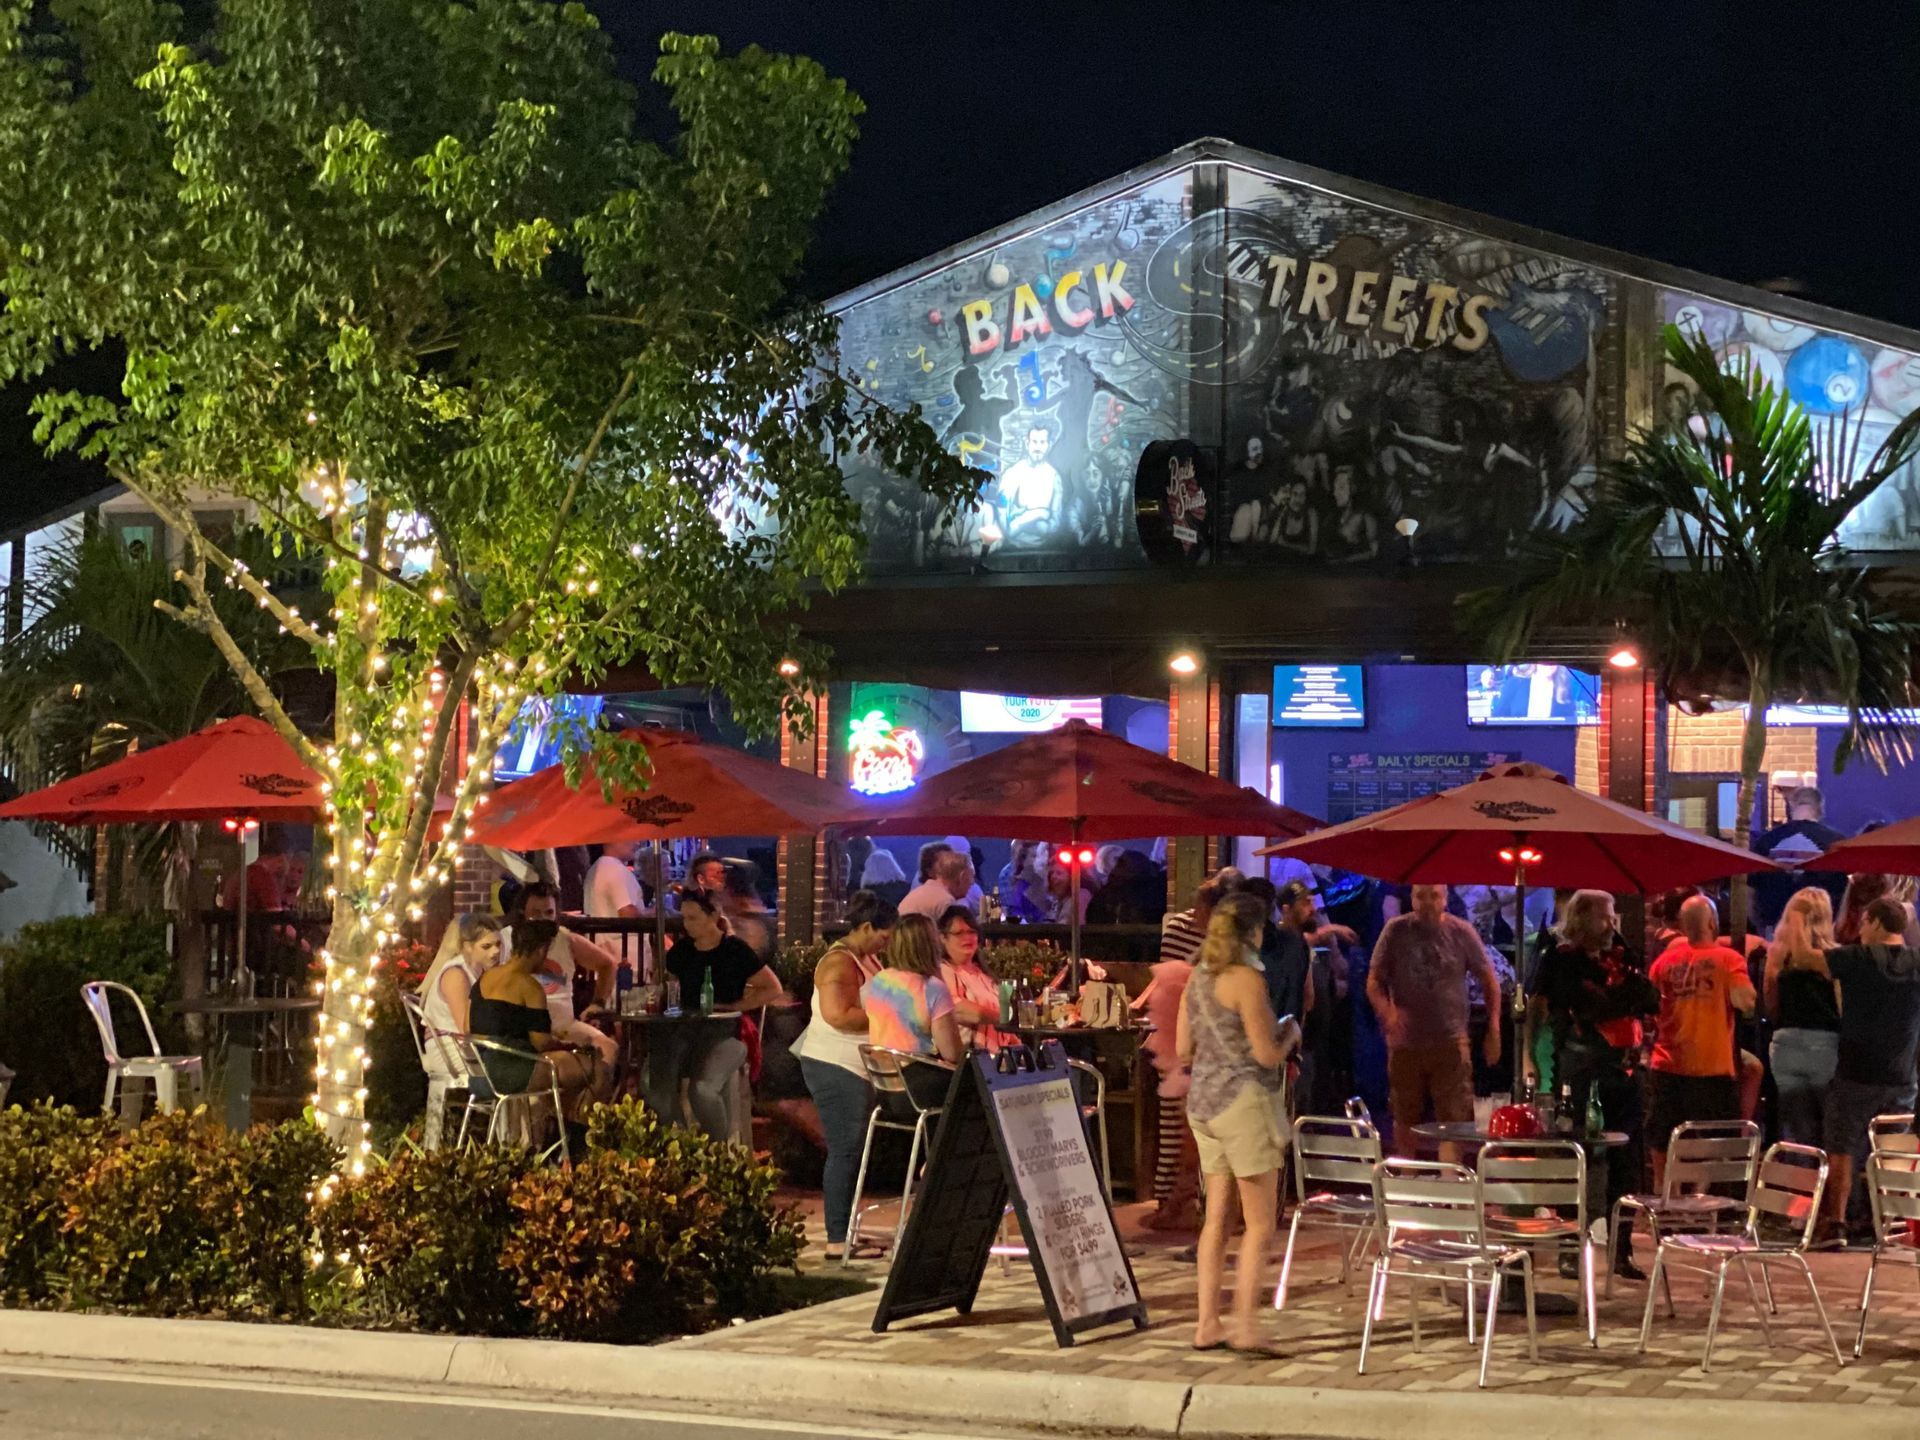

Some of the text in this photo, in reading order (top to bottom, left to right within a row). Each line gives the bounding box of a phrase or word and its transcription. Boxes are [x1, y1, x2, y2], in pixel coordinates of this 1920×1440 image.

[963, 259, 1136, 356] BACK
[1020, 708, 1041, 717] 2020
[1378, 755, 1411, 767] DAILY
[1413, 755, 1470, 767] SPECIALS
[1036, 1087, 1070, 1104] SPECIALS
[1051, 1138, 1079, 1155] MARYS
[1035, 1206, 1043, 1219] 2
[1072, 1194, 1096, 1212] PORK
